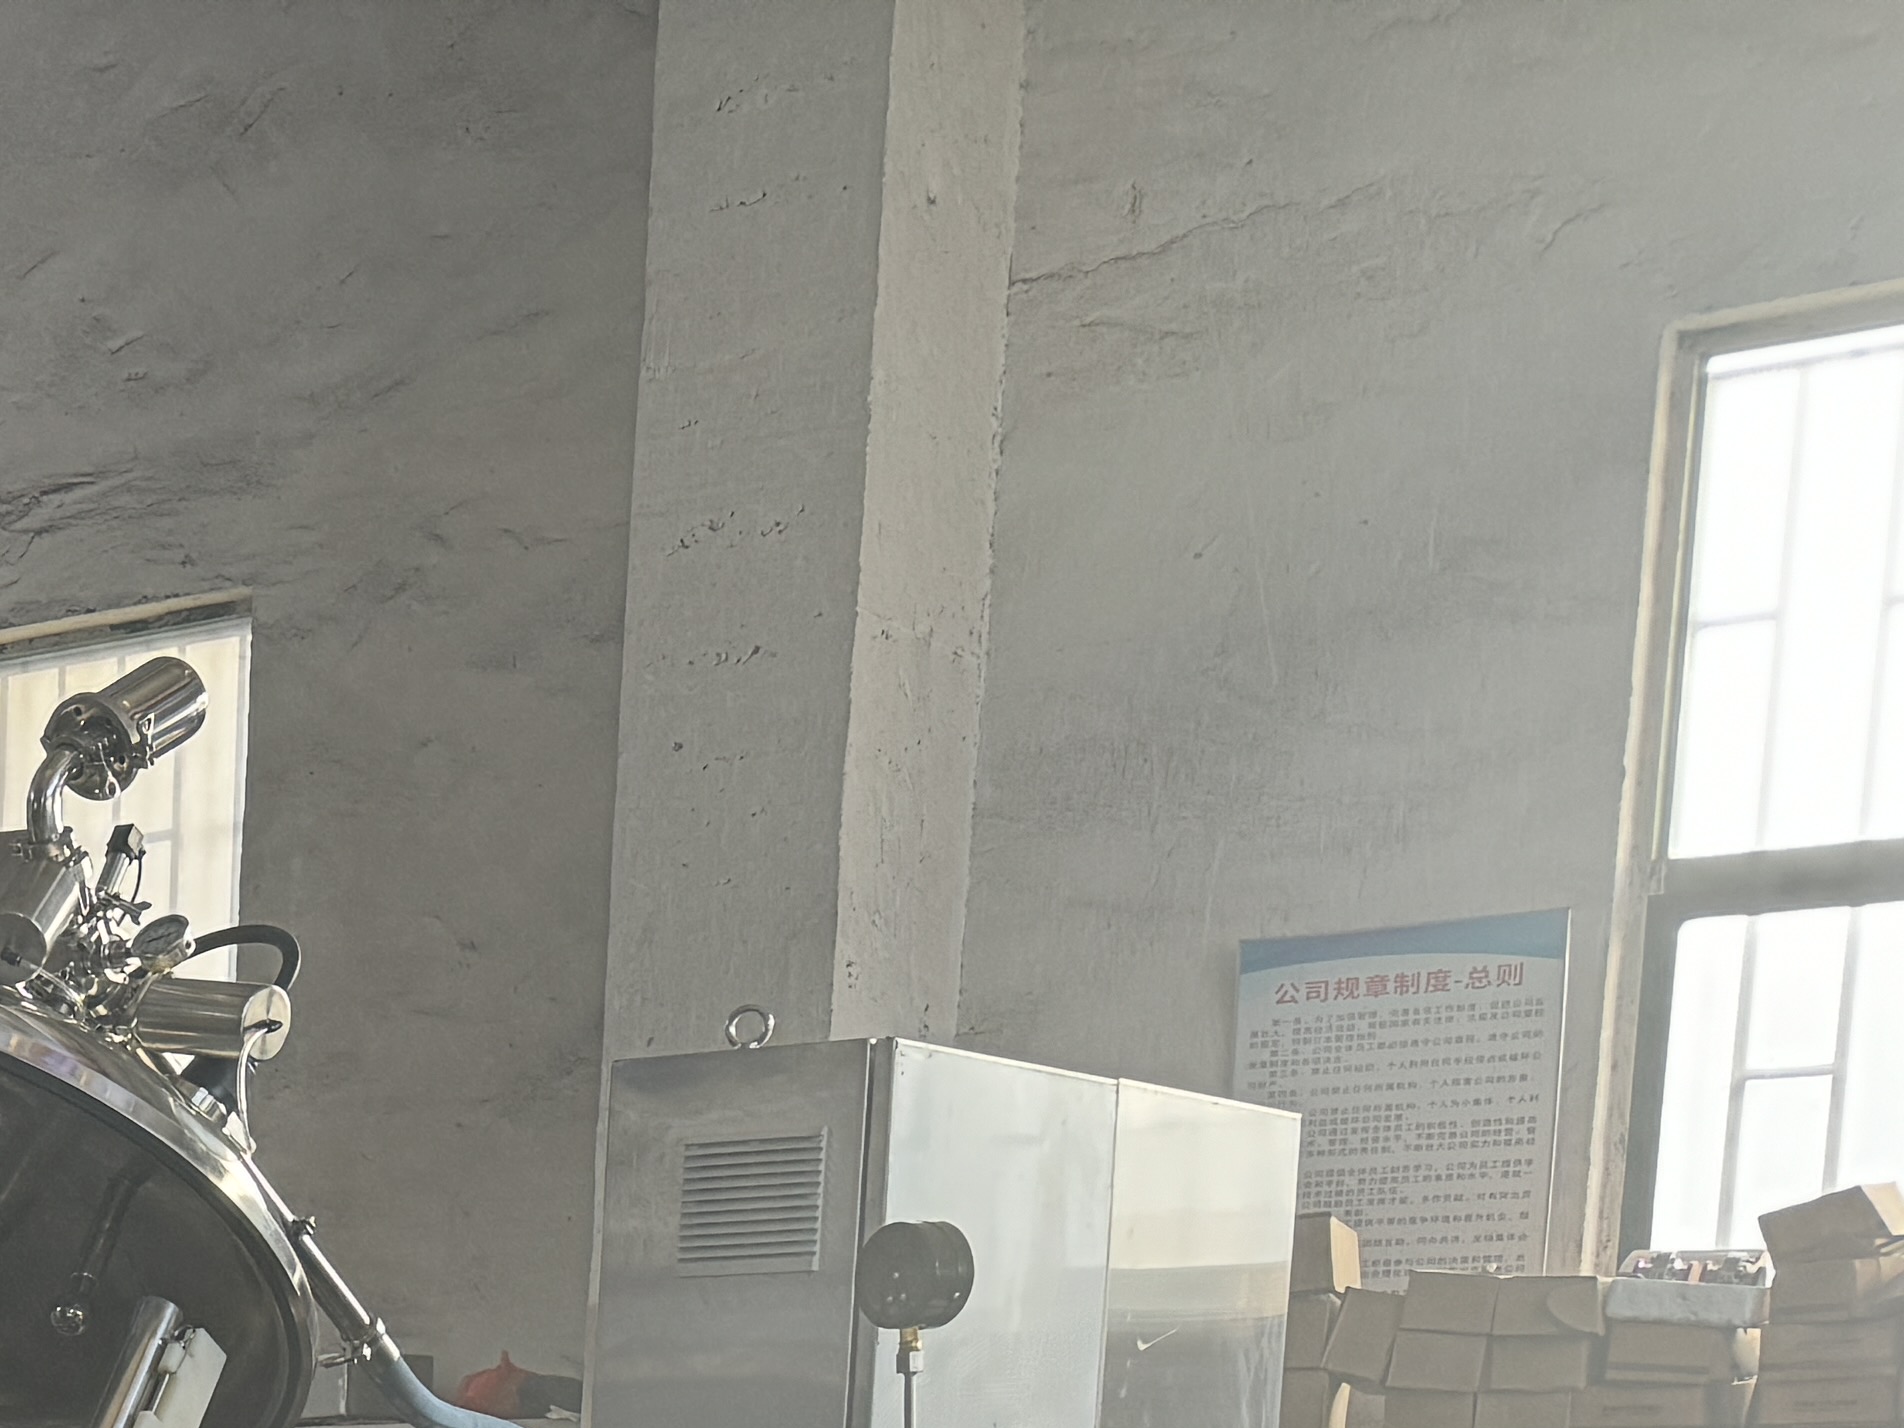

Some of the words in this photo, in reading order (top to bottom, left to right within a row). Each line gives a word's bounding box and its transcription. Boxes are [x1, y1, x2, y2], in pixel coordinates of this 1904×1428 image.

[1274, 962, 1525, 1005] 公司规章制度-总则
